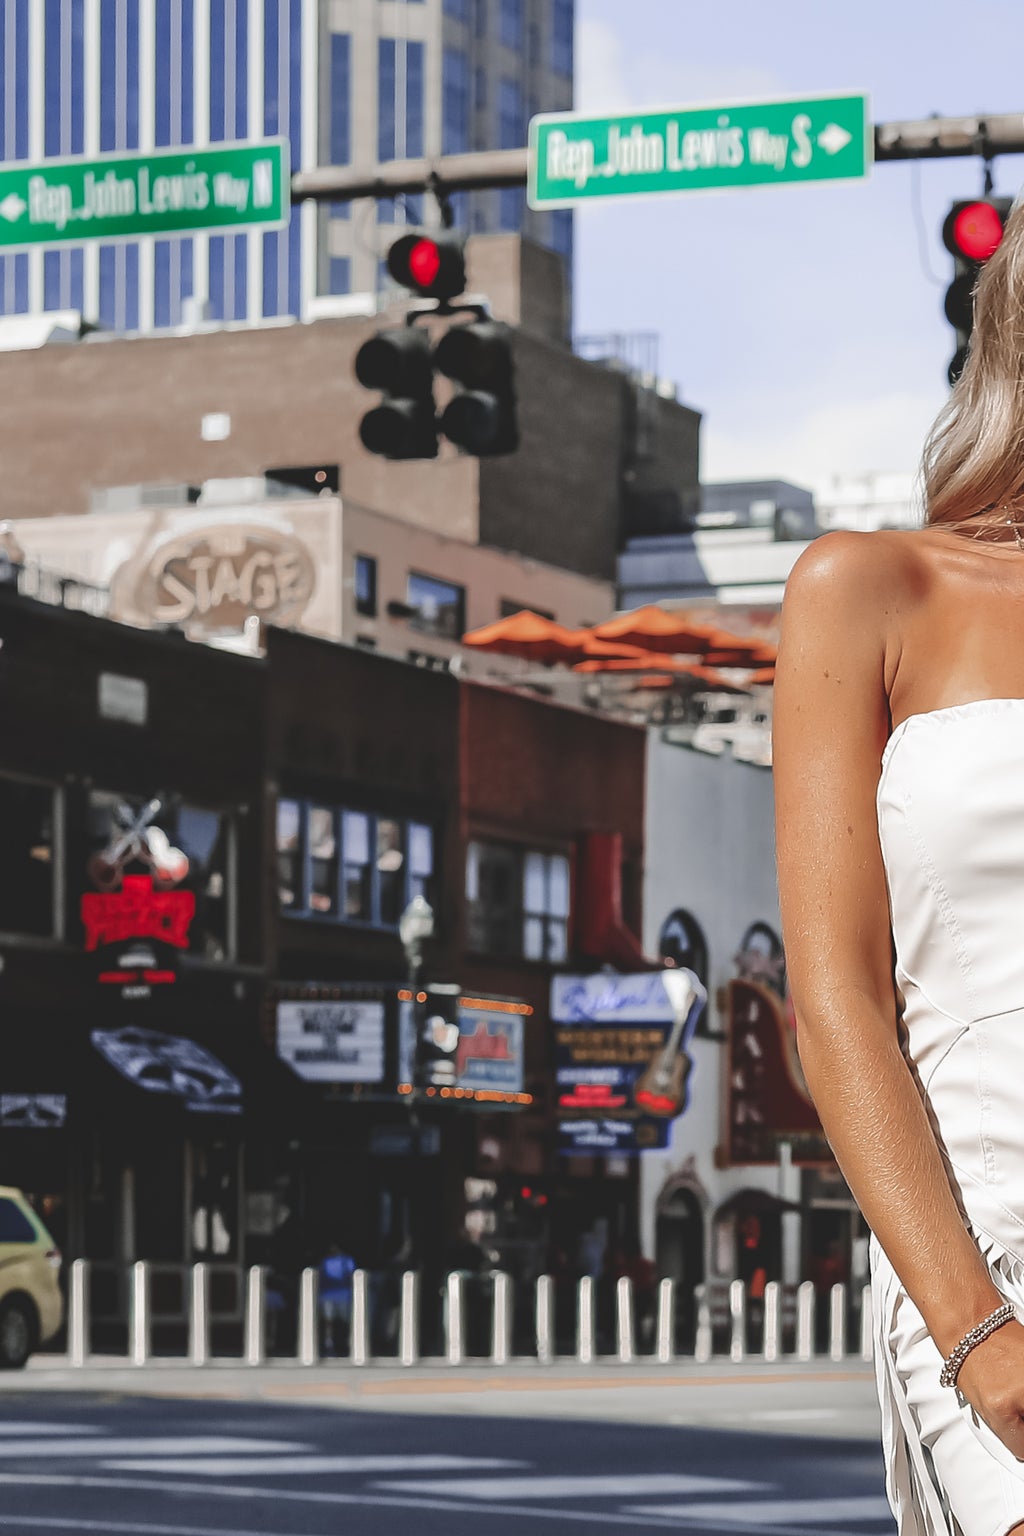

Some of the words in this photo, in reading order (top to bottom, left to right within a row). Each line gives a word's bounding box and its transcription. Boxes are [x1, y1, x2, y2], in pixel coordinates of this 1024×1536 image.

[546, 129, 599, 190] Rep.
[600, 122, 665, 178] John
[665, 114, 745, 173] Lewis
[748, 126, 789, 172] Way
[791, 113, 813, 169] S
[77, 169, 137, 221] John
[138, 160, 209, 215] Lewis
[213, 172, 250, 213] Way
[252, 158, 273, 209] N
[150, 549, 304, 623] STAGE
